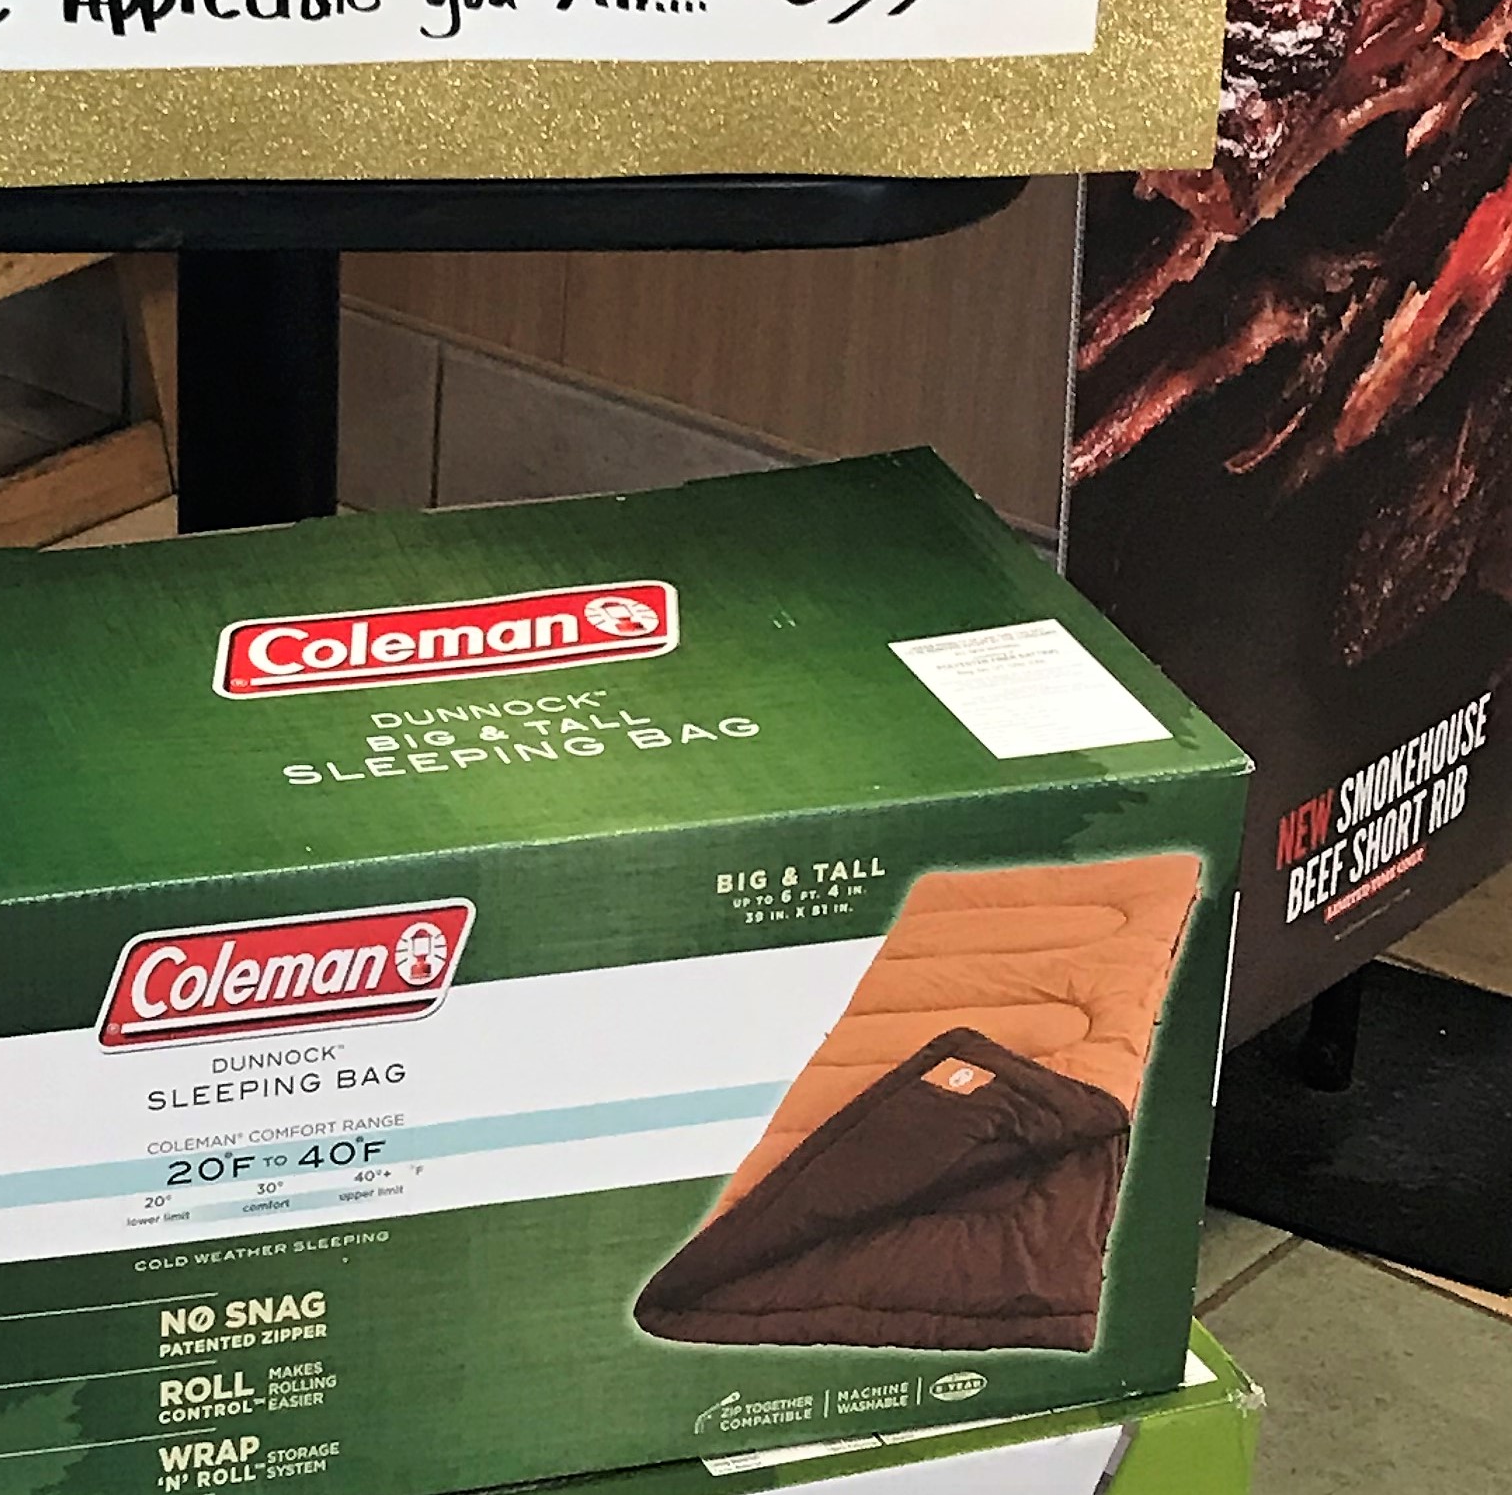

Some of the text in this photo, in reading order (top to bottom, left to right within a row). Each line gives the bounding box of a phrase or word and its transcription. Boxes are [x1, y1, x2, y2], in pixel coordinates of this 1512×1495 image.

[248, 611, 580, 677] Coleman
[283, 716, 763, 786] SLEEPING BAG
[364, 710, 652, 755] BIG & TALL
[1277, 691, 1492, 871] NEW SMOKEHOUSE
[1286, 764, 1470, 925] BEEF SHORT RIB
[716, 857, 886, 895] BIG & TALL
[131, 940, 389, 1020] Coleman
[147, 1061, 408, 1112] SLEEPING BAG
[247, 1120, 337, 1145] COMFORT
[341, 1112, 406, 1132] RANGE
[134, 1230, 391, 1273] COLD WEATHER SLEEPING
[224, 1290, 327, 1330] SNAG
[159, 1323, 328, 1359] PATENTED ZIPPER
[159, 1360, 324, 1409] ROLL MAKES
[267, 1374, 338, 1396] ROLLING
[267, 1391, 325, 1412] EASIER
[744, 1393, 815, 1415] TOGETHER
[836, 1381, 910, 1402] MACHINE
[719, 1407, 814, 1434] COMPATIBLE
[836, 1394, 910, 1416] WASHABLE
[158, 1435, 340, 1474] WRAP STORAGE
[266, 1459, 328, 1480] SYSTEM
